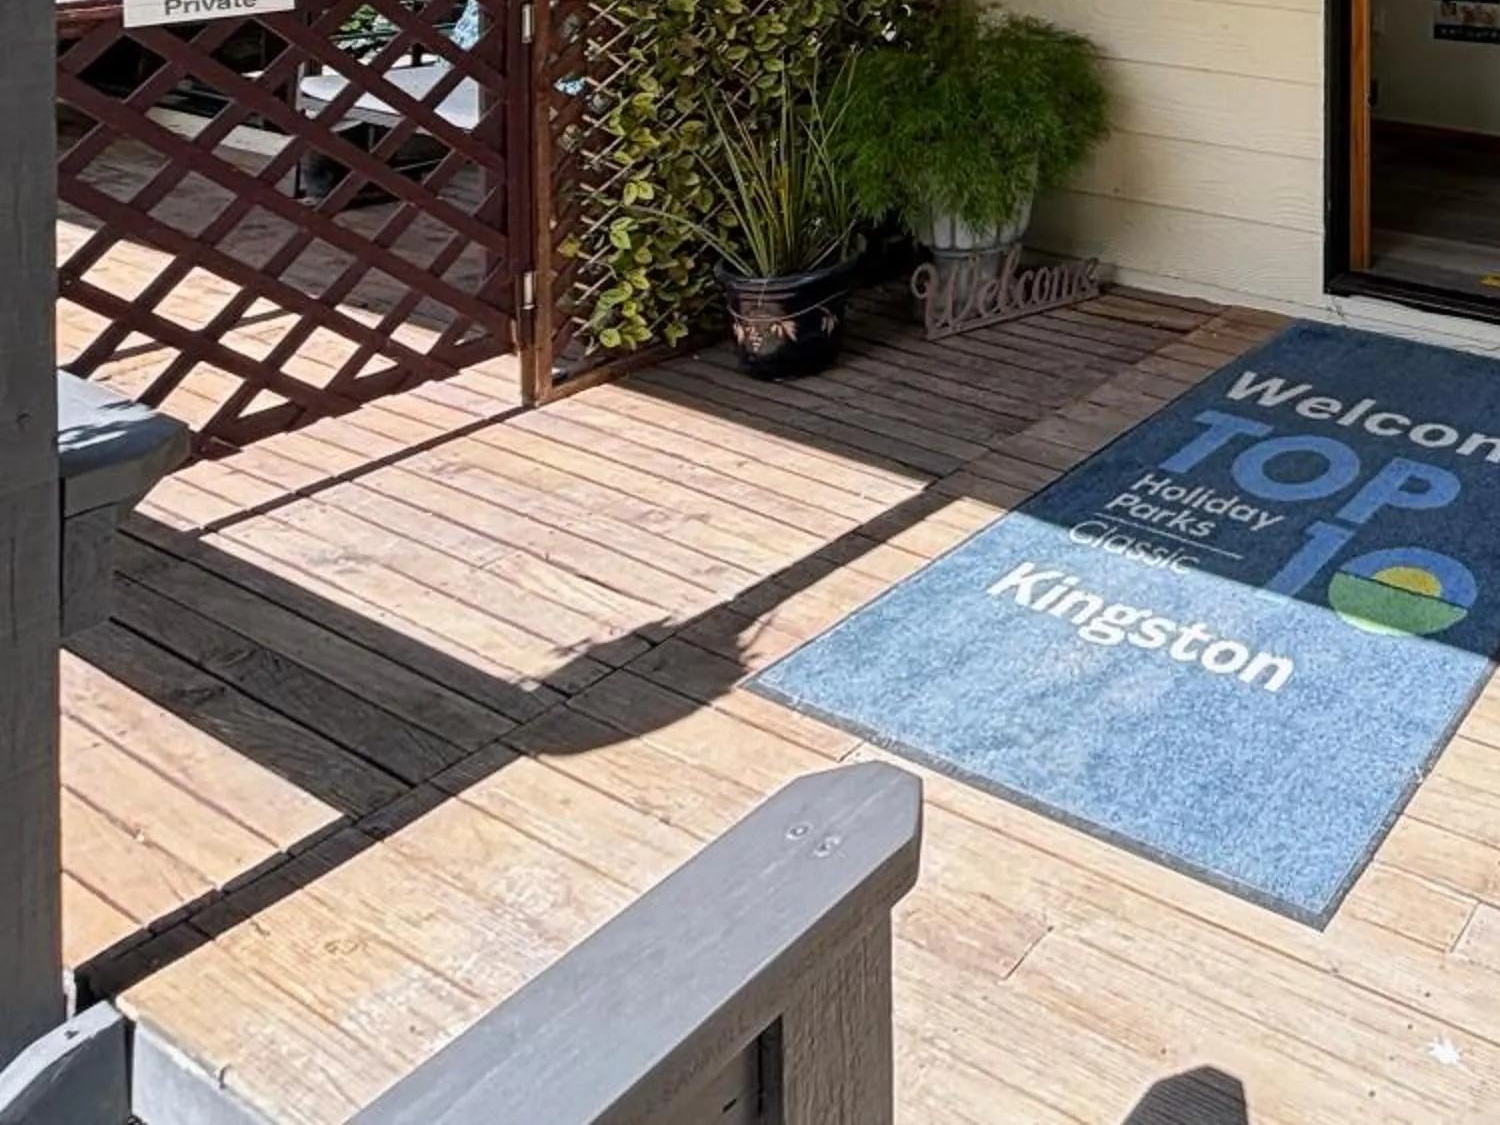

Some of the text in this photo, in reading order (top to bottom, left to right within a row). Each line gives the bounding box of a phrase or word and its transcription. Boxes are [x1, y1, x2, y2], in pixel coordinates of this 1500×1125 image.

[1158, 409, 1462, 525] TOP
[1105, 492, 1216, 537] Parks
[1131, 472, 1286, 532] Holiday
[1067, 520, 1200, 574] Classic
[986, 561, 1295, 693] Kingston
